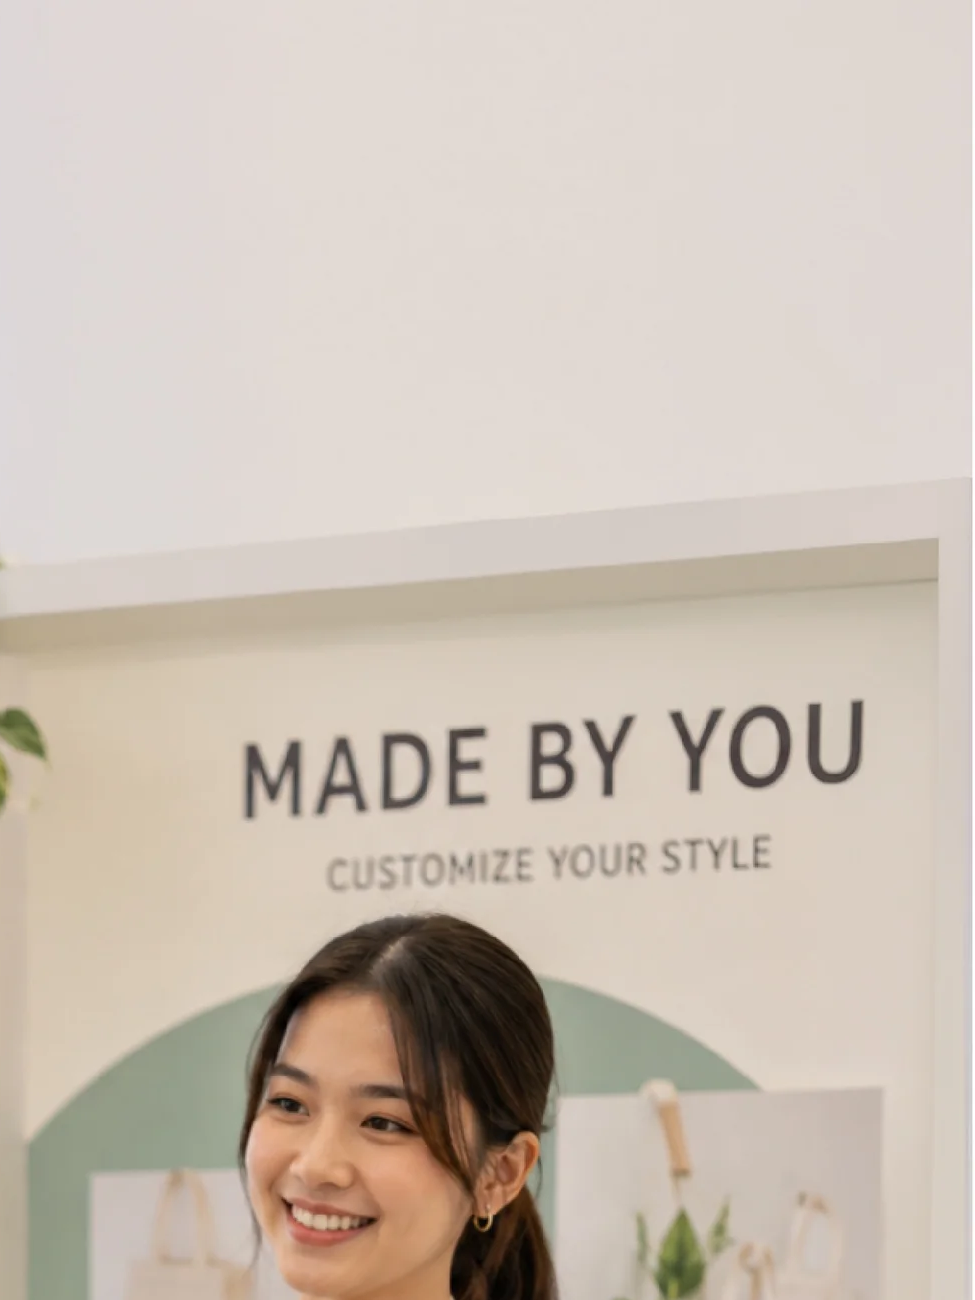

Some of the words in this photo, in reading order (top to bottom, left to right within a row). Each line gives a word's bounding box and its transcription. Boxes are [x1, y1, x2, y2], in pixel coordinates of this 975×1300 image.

[243, 726, 488, 820] MADE
[528, 714, 637, 802] BY
[669, 699, 865, 794] YOU
[326, 847, 533, 892] CUSTOMIZE
[548, 841, 647, 879] YOUR
[661, 835, 773, 875] STYLE
